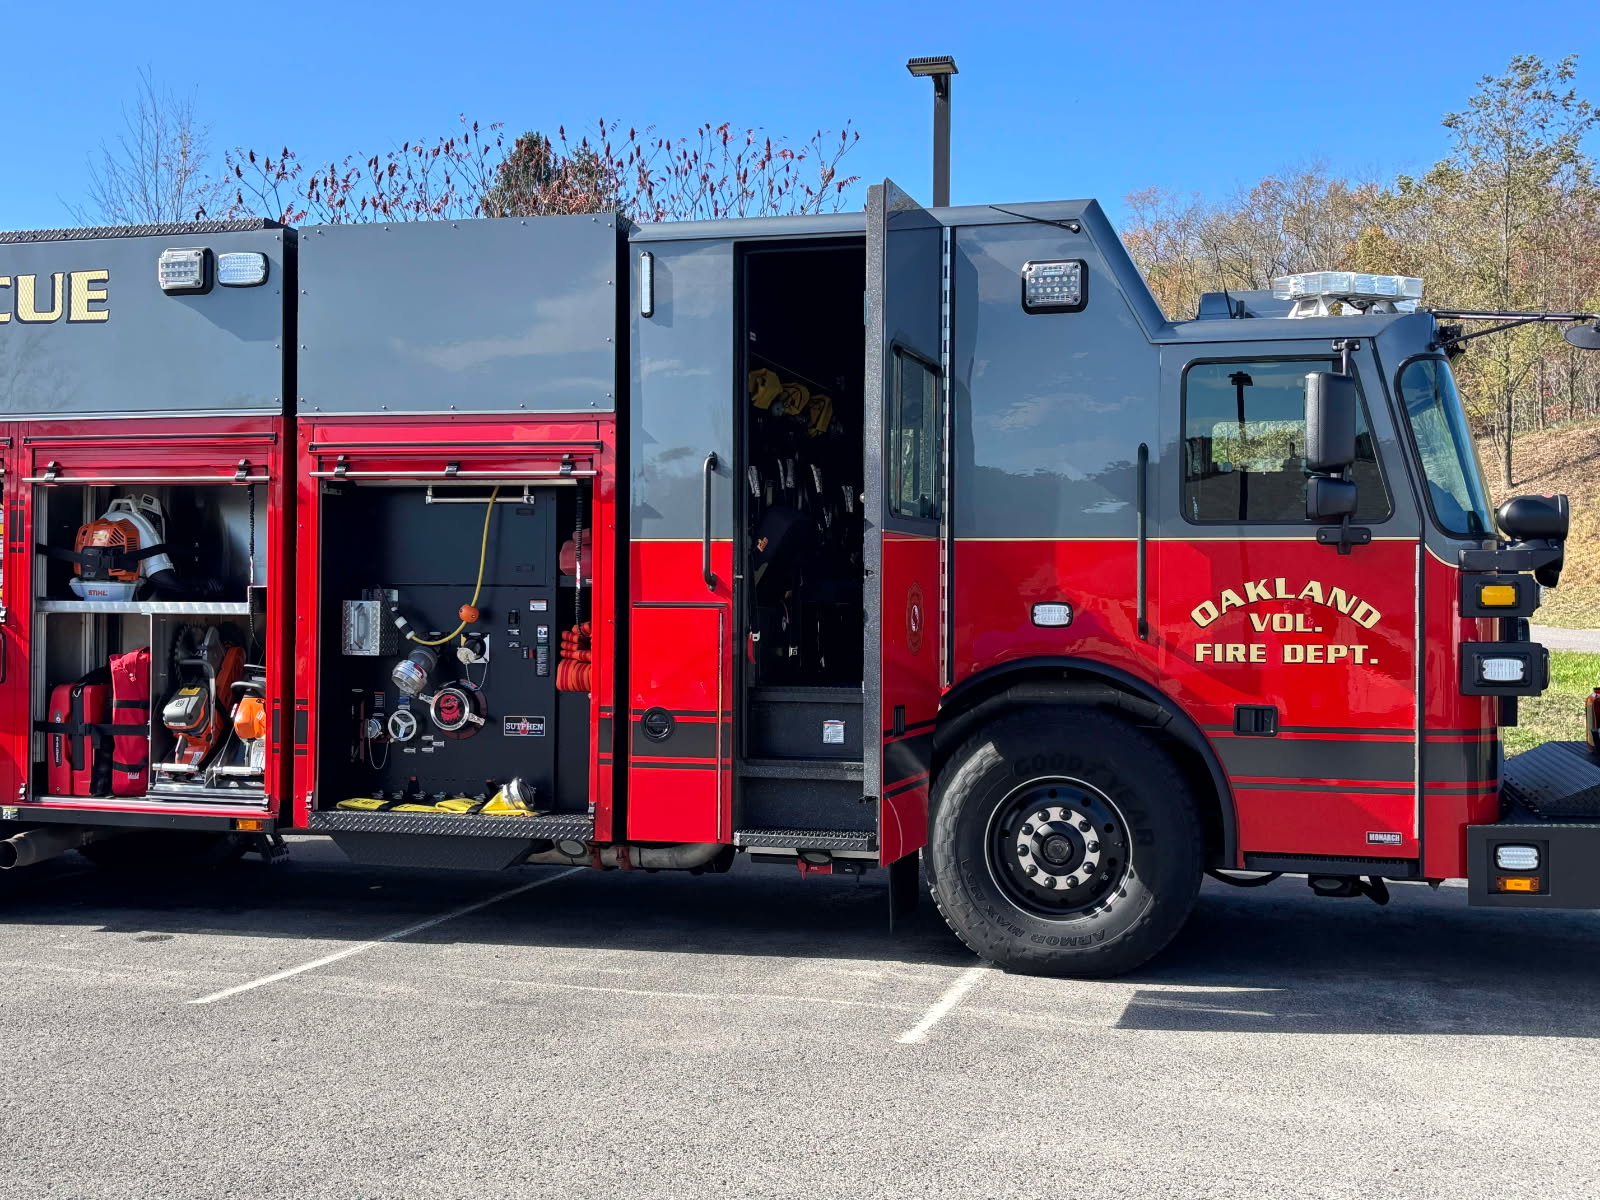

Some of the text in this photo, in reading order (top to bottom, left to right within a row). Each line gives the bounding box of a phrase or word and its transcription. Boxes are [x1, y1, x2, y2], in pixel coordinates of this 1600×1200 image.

[0, 269, 110, 323] UE
[1190, 577, 1382, 629] OAKLAND
[1249, 613, 1323, 632] VOL.
[1195, 643, 1378, 664] FIRE DEPT.
[505, 722, 544, 731] SUTPHEN
[1369, 833, 1400, 842] MONARCH
[985, 904, 1026, 939] MAX
[1030, 928, 1107, 947] ARMOR
